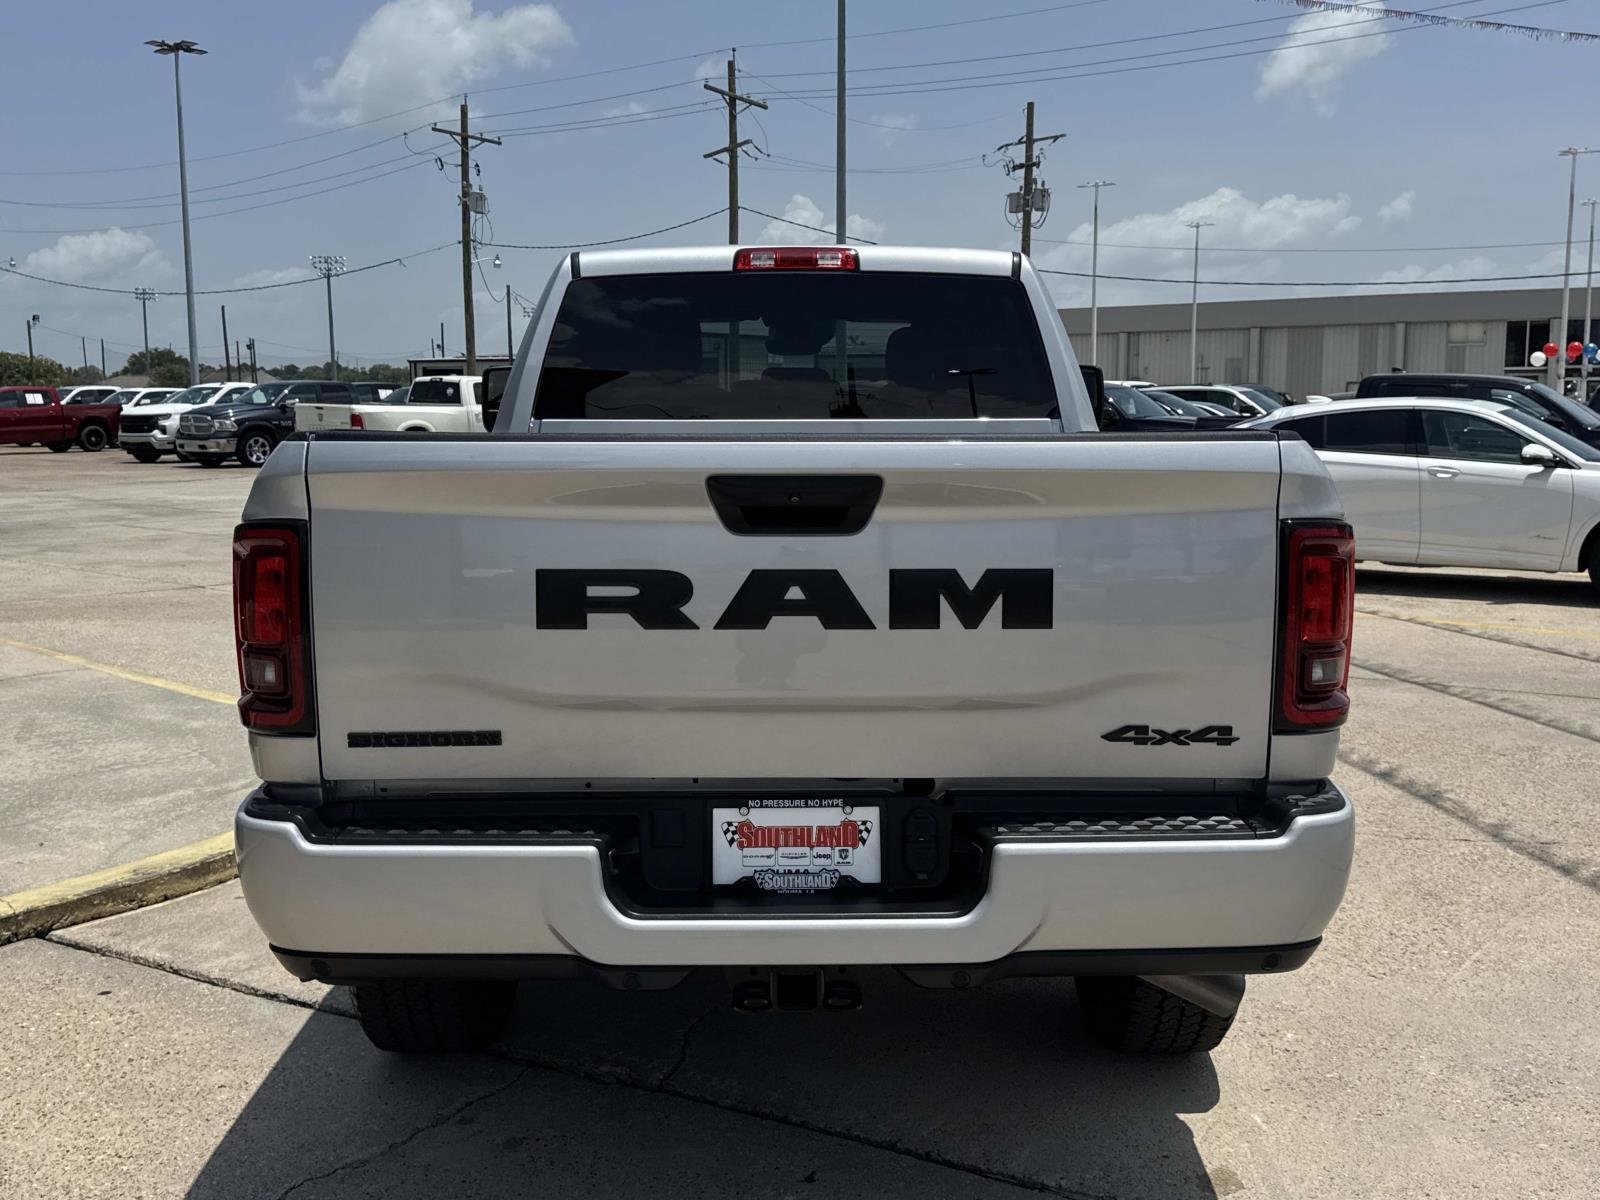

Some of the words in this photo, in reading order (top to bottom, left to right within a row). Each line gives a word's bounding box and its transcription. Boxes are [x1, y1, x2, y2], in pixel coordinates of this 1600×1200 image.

[536, 568, 1053, 630] RAM
[1100, 724, 1240, 746] 4x4
[748, 799, 760, 808] NO
[763, 799, 806, 807] PRESSURE
[808, 799, 820, 807] NO
[822, 799, 844, 807] HYPE
[813, 852, 831, 860] Jeep
